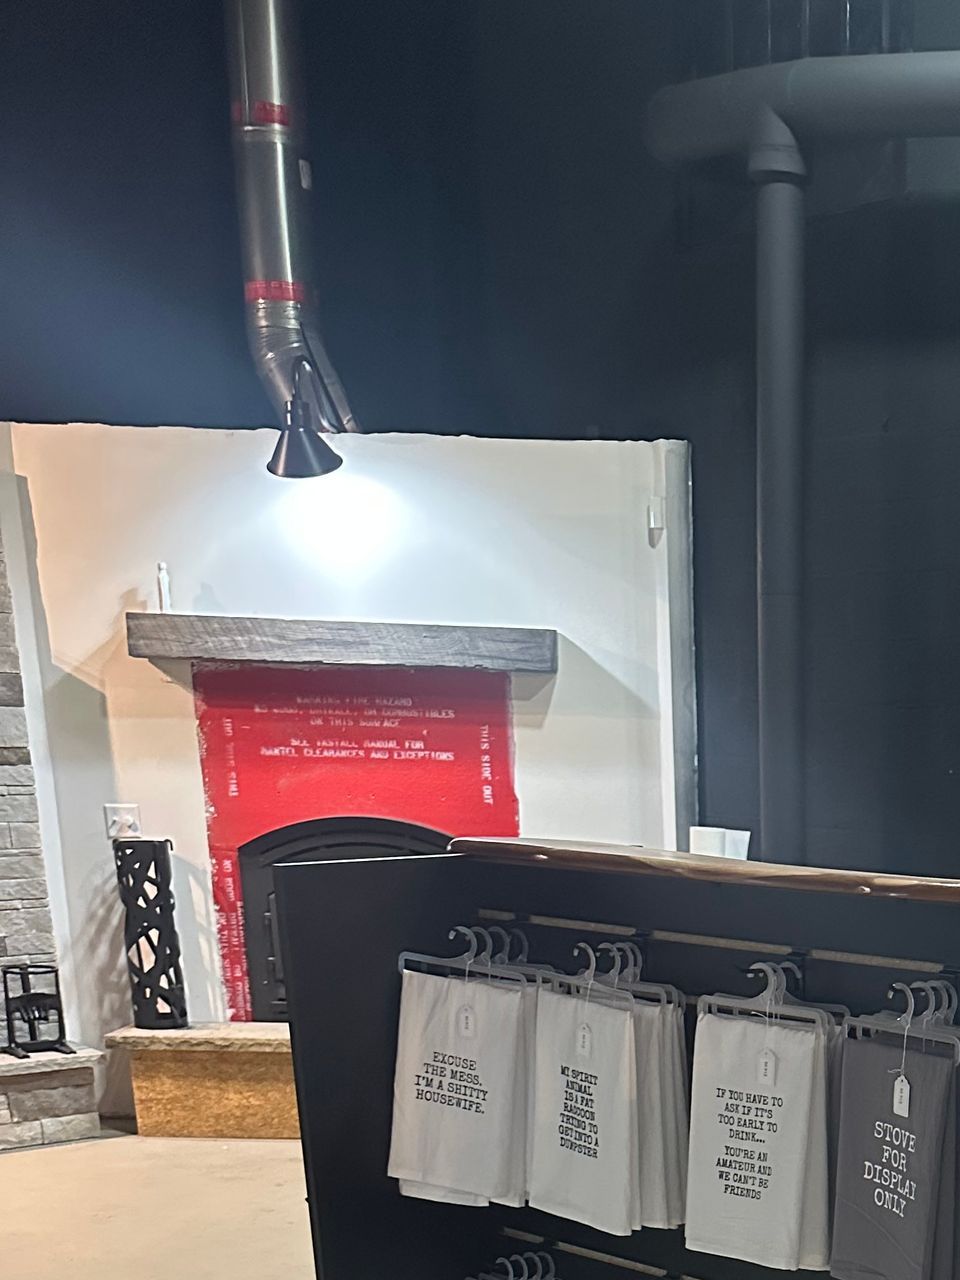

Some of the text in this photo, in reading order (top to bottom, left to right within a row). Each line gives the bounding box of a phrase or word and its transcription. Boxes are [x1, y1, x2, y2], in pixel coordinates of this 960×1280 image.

[303, 747, 365, 758] CLEARANCES
[370, 750, 389, 759] AND
[393, 751, 455, 760] EXCEPTIONS
[404, 740, 425, 750] FOR
[480, 725, 494, 805] THIS SIDE OUT
[432, 1051, 477, 1071] EXCUSE
[423, 1063, 482, 1086] THE MESS.
[571, 1069, 598, 1085] SPIRIT
[414, 1074, 488, 1101] I'M A SHITTY
[565, 1080, 593, 1096] ANIMAL
[716, 1087, 784, 1108] IF YOU HAVE TO
[415, 1089, 485, 1114] HOUSEWIFE.
[564, 1090, 574, 1101] IS
[580, 1096, 594, 1109] FAT
[563, 1102, 596, 1121] RACCOON
[724, 1102, 773, 1119] ASK IF IT'S
[560, 1113, 599, 1135] TRYING TO
[717, 1113, 778, 1133] TOO EARLY TO
[558, 1124, 599, 1147] GET INTO A
[729, 1128, 766, 1144] DRINK...
[874, 1121, 917, 1153] STOVE
[559, 1136, 598, 1159] DUMPSTER
[724, 1145, 768, 1162] YOU'RE AN
[715, 1157, 772, 1177] AMATEUR AND
[882, 1145, 907, 1172] FOR
[718, 1170, 769, 1189] WE CAN'T BE
[863, 1161, 917, 1200] DISPLAY
[723, 1184, 762, 1200] FRIENDS
[874, 1188, 907, 1218] ONLY
